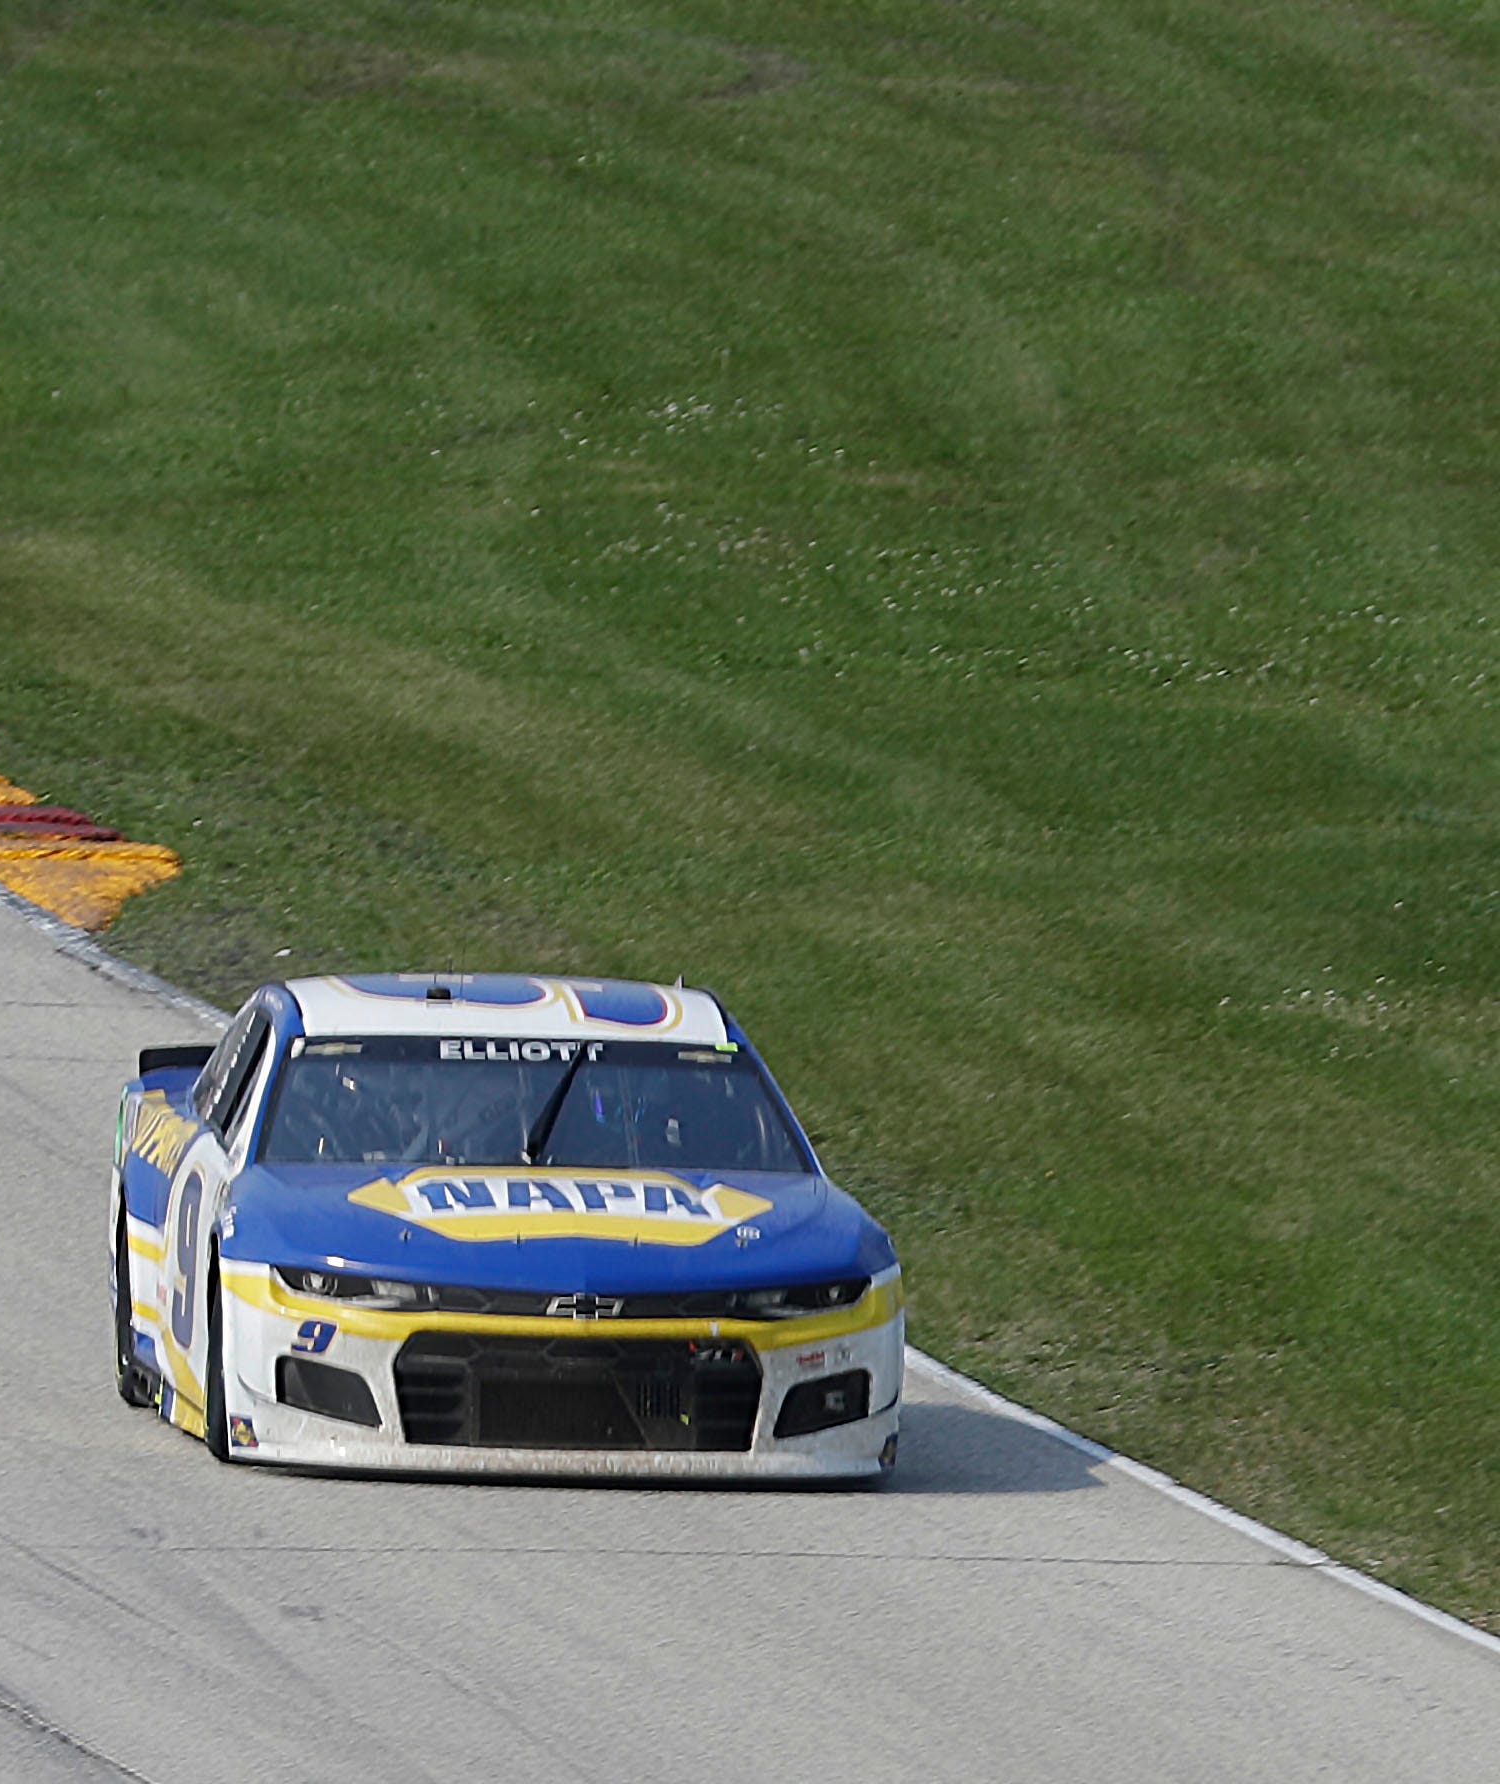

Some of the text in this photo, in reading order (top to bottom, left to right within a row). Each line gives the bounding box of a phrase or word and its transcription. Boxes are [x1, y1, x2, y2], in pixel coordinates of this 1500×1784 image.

[439, 1039, 603, 1062] ELLIOTT
[417, 1179, 713, 1219] NAPA
[171, 1169, 205, 1351] 9
[290, 1319, 339, 1354] 9
